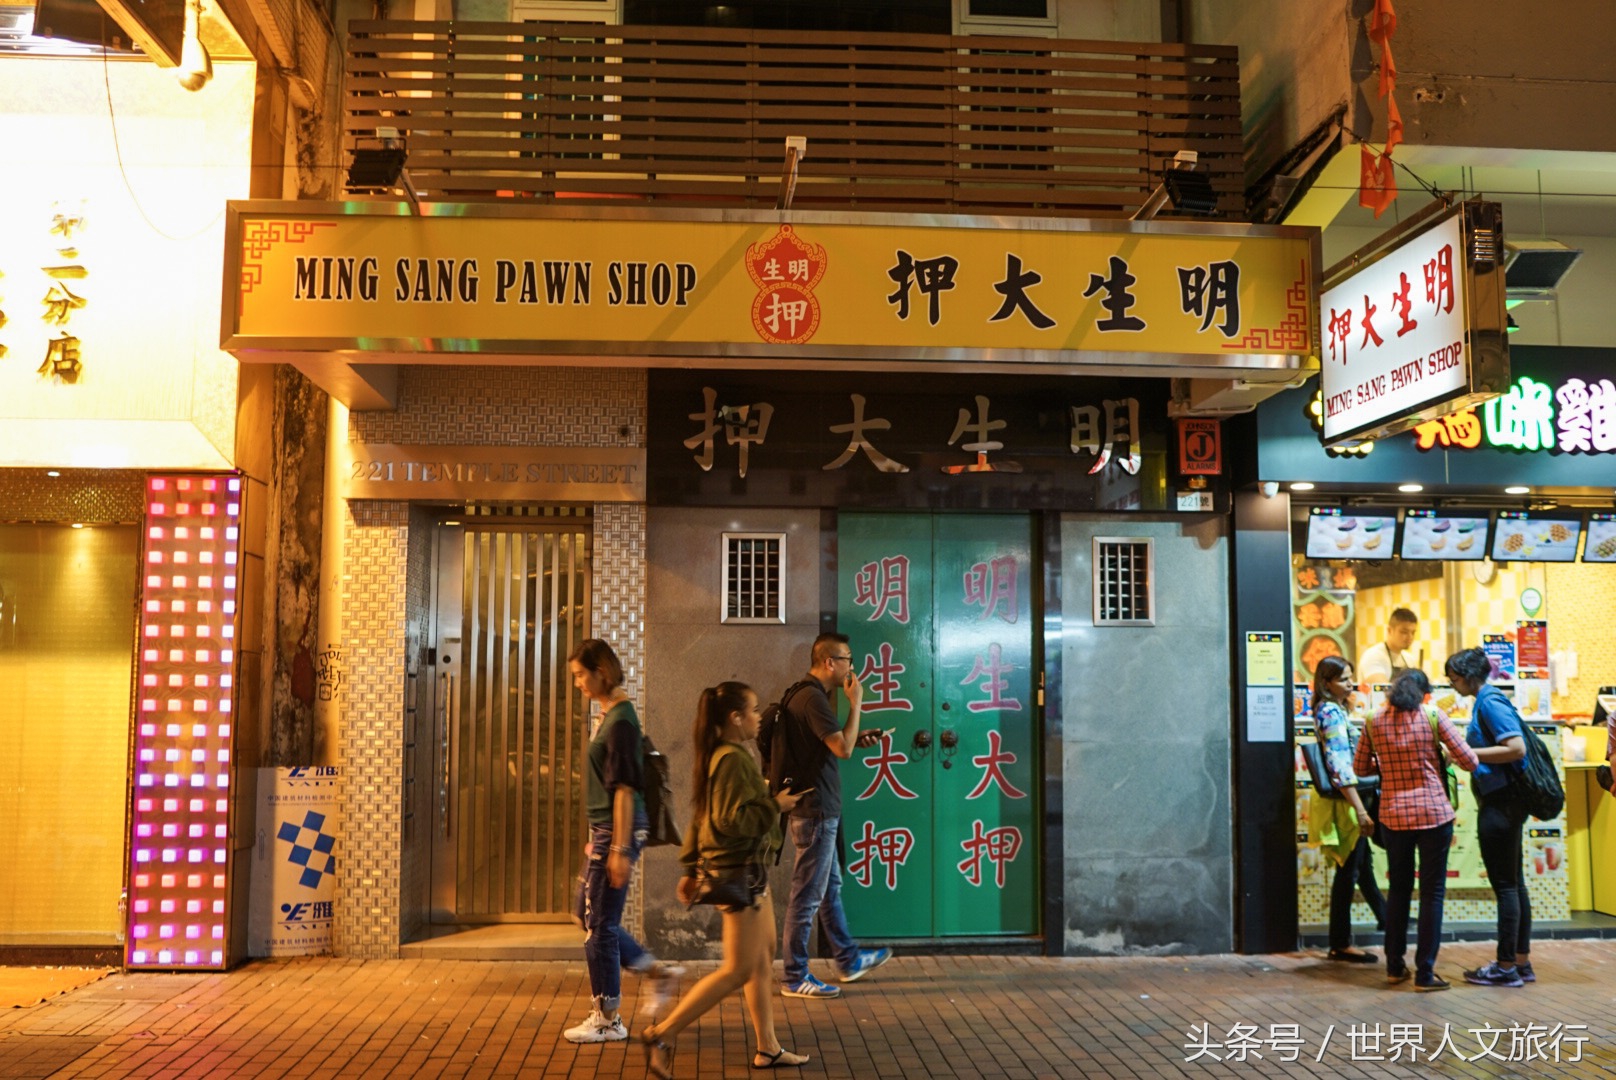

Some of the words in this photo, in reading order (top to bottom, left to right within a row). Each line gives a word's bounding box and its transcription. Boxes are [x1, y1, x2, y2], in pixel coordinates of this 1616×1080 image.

[294, 256, 379, 301] MING
[395, 258, 480, 303] SANG
[494, 260, 591, 306] PAWN
[607, 262, 697, 307] SHOP
[763, 293, 808, 337] 押
[1326, 389, 1353, 419] MING
[1357, 374, 1386, 405] SANG
[1391, 357, 1424, 392] PAWN
[1428, 341, 1463, 376] SHOP
[1185, 422, 1216, 430] JOHNSON
[1193, 434, 1207, 458] J
[350, 461, 395, 482] 221
[401, 461, 519, 483] TEMPLE
[525, 462, 638, 484] STREET
[1187, 462, 1216, 471] ALARMS
[848, 554, 920, 891] 明生大押
[956, 554, 1028, 889] 明生大押
